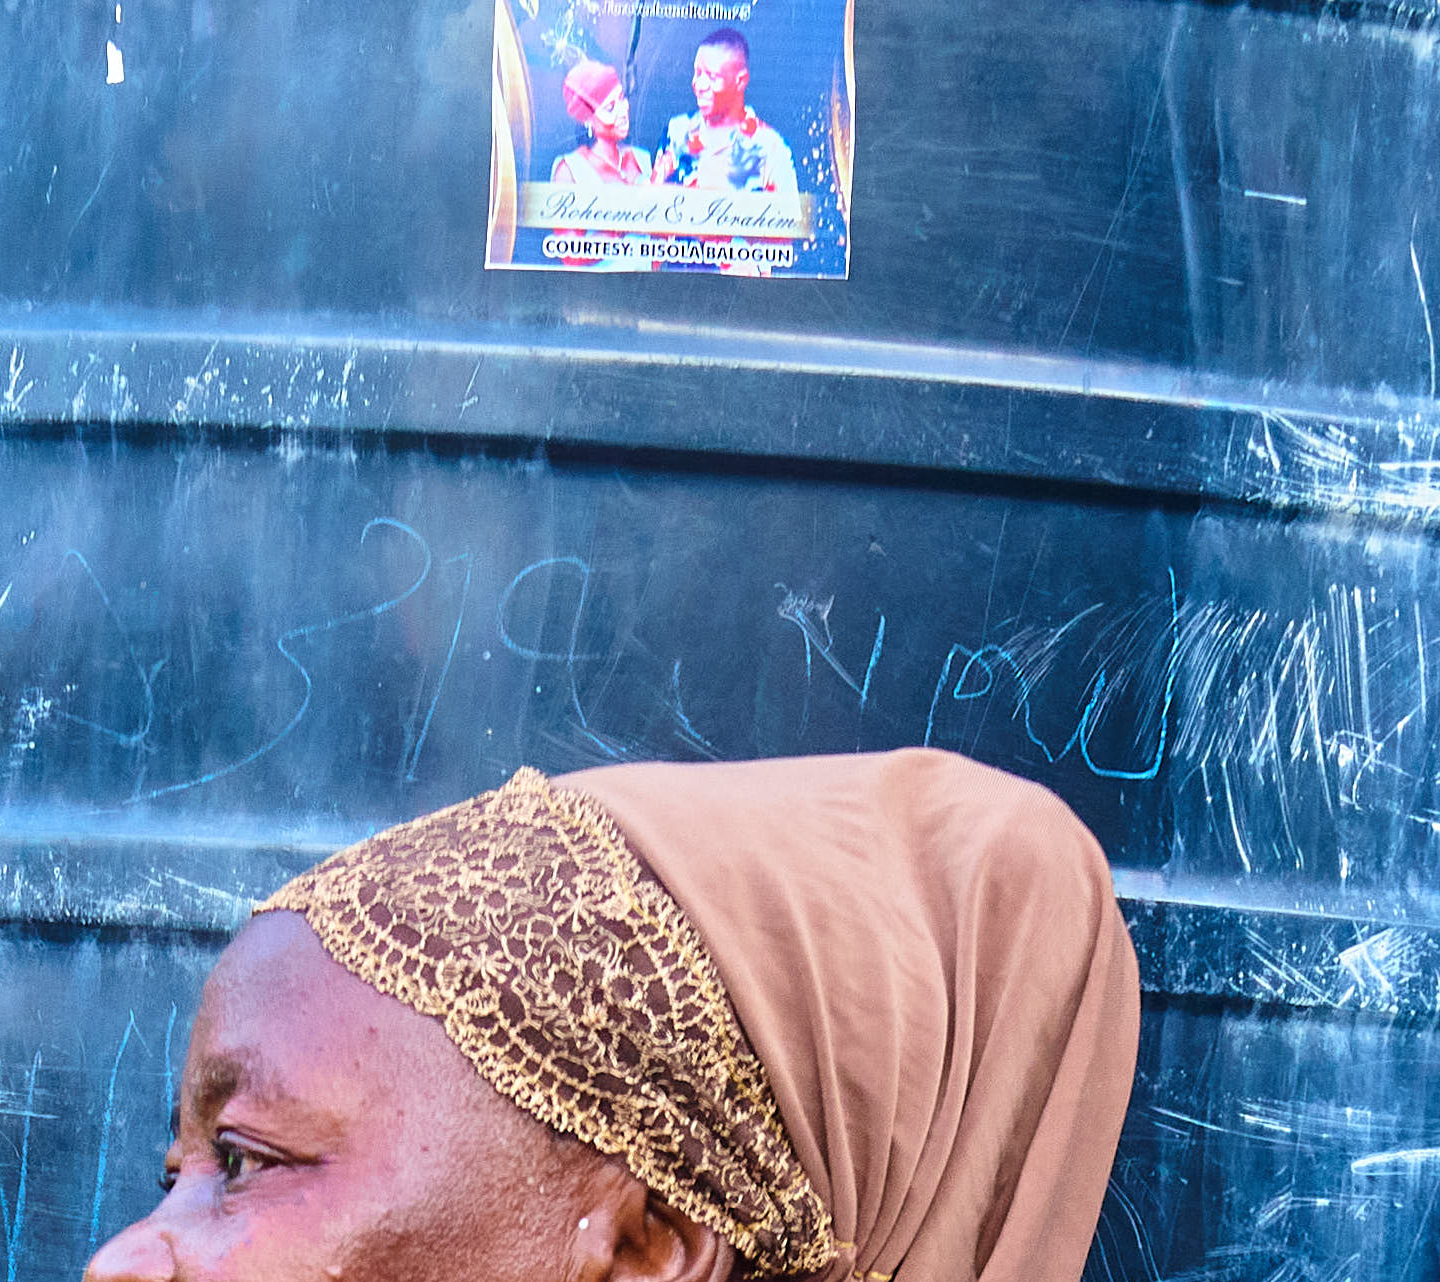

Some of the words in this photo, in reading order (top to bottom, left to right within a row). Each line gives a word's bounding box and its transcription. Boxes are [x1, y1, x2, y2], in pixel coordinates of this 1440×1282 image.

[690, 198, 797, 230] Ibrahim
[545, 240, 634, 258] COURTESY:
[639, 243, 700, 260] BISOLA
[706, 246, 790, 263] BALOGUN
